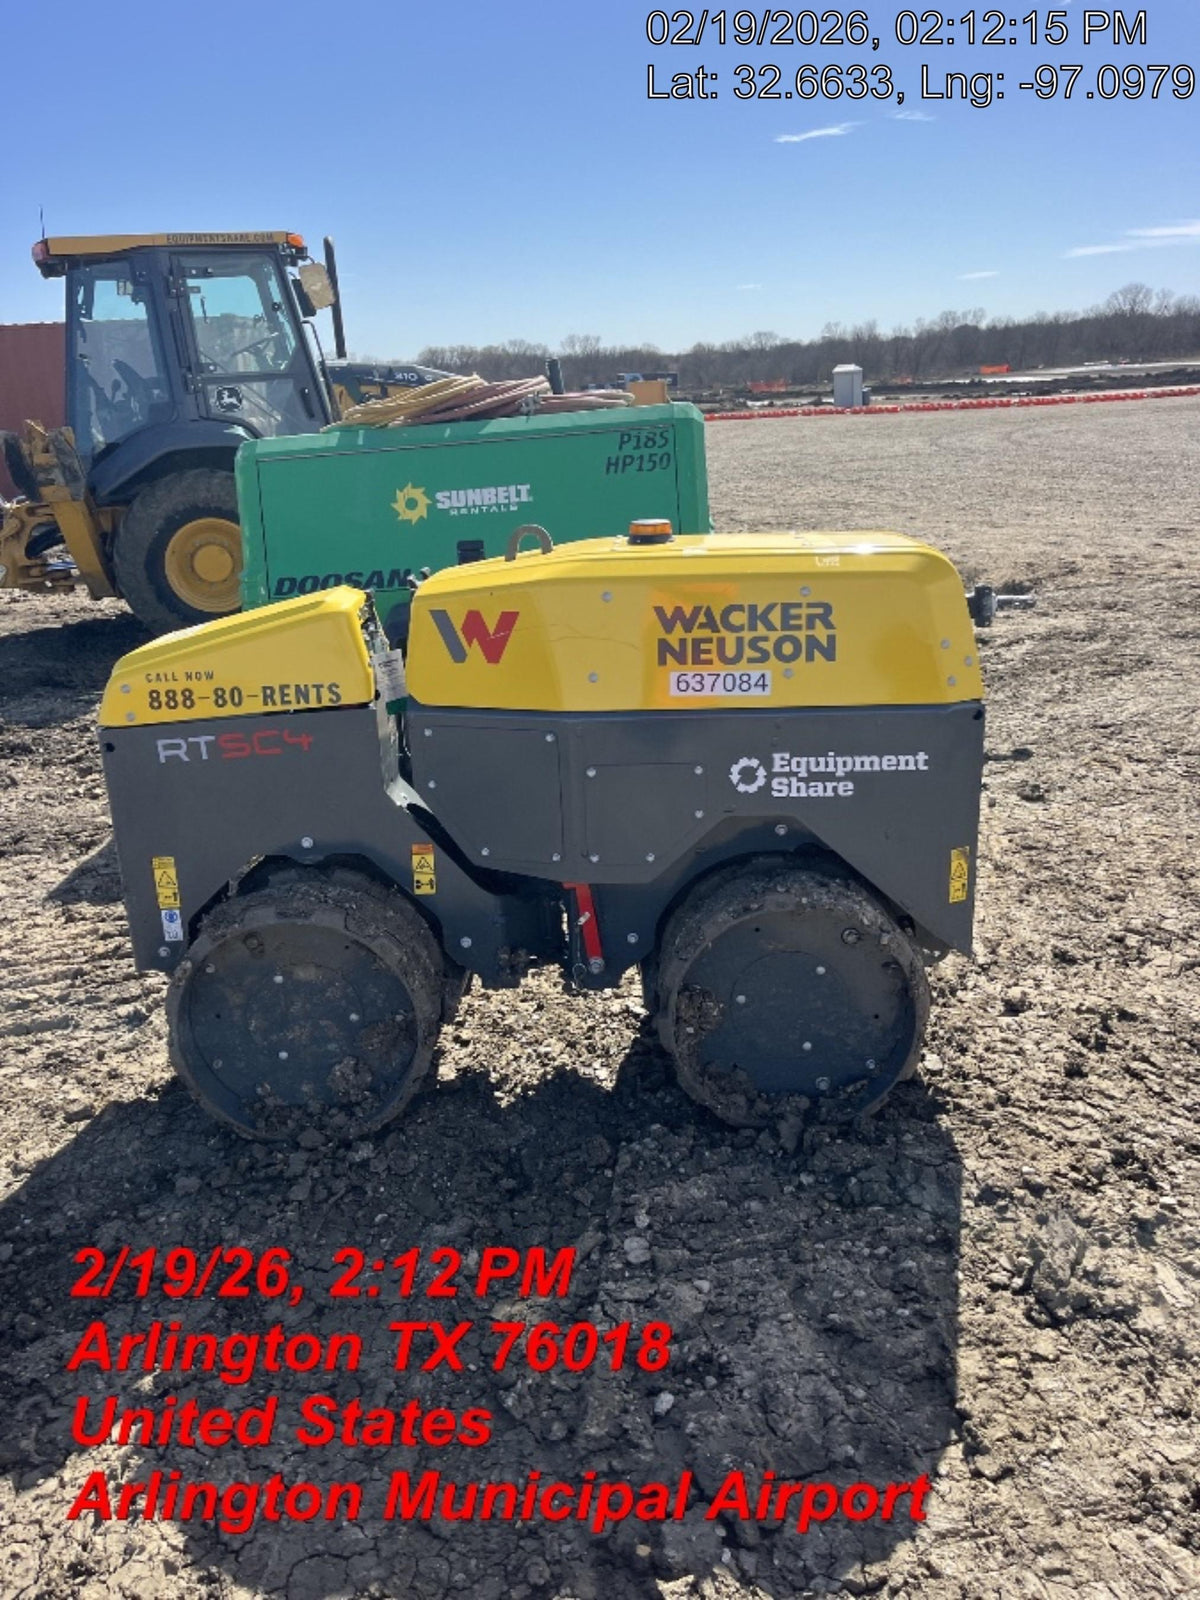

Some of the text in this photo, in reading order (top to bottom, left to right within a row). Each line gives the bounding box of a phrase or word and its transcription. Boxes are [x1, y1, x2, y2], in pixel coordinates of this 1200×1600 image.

[618, 429, 669, 451] P185
[605, 452, 671, 475] HP150
[435, 484, 531, 509] SUNBELT
[273, 568, 411, 596] DOOSAN
[653, 602, 837, 633] WACKER
[657, 634, 836, 666] NEUSON
[145, 670, 214, 683] CALL NOW
[676, 673, 769, 692] 637084
[148, 682, 342, 710] 888-80-RENTS
[771, 752, 929, 777] Equipment
[771, 776, 854, 797] Share
